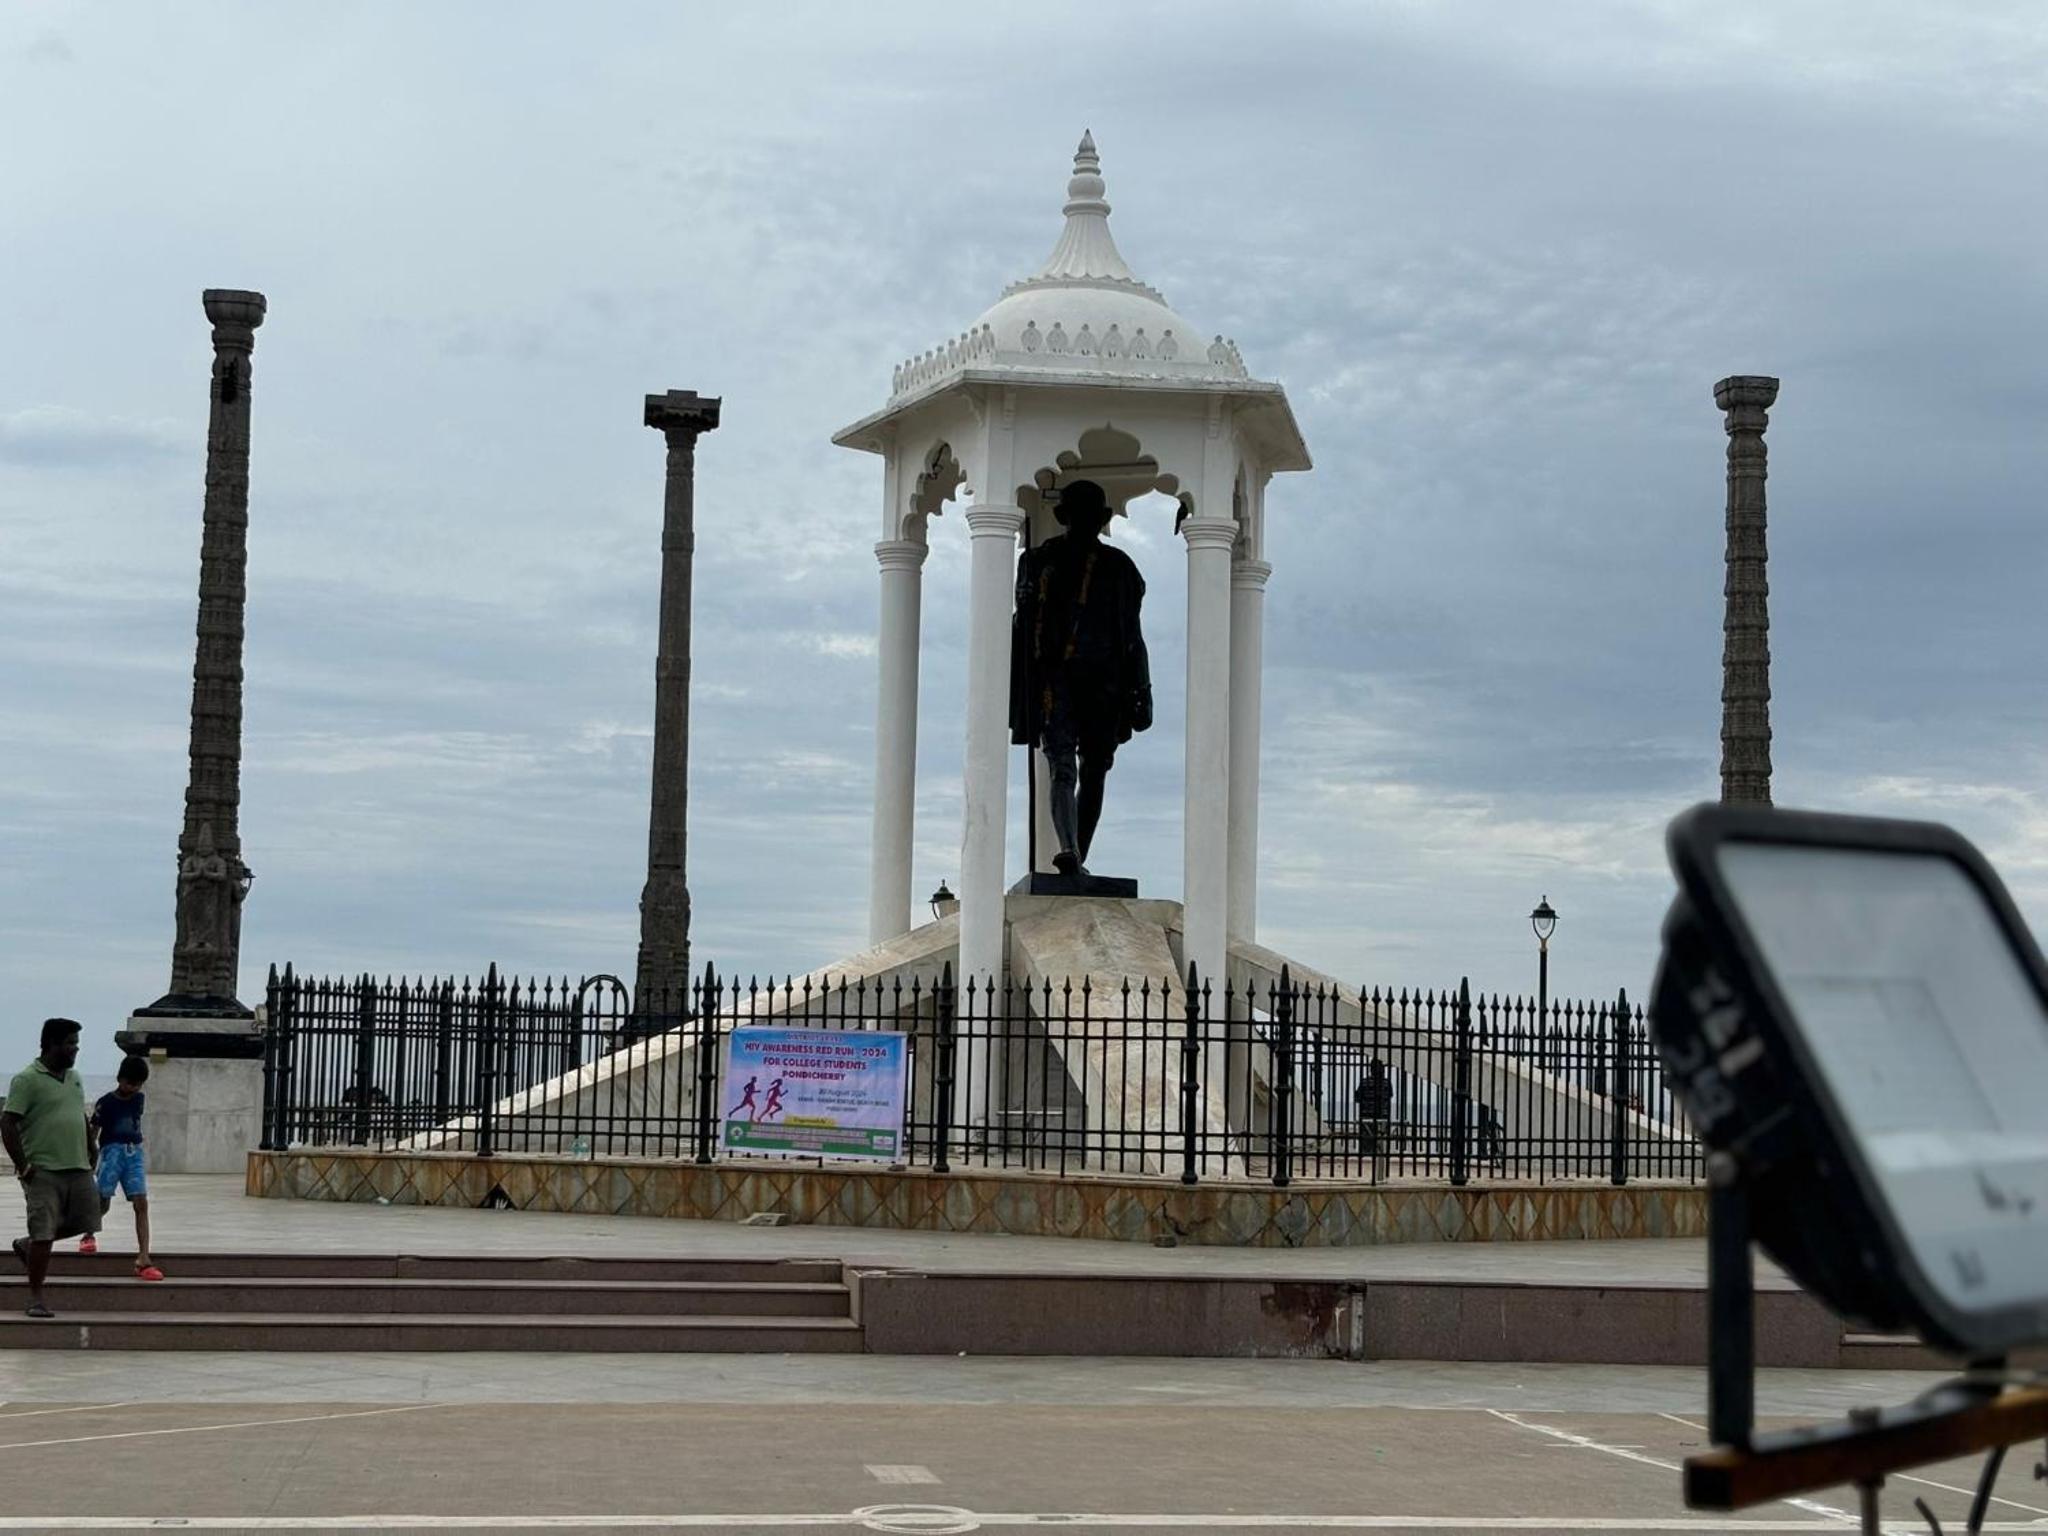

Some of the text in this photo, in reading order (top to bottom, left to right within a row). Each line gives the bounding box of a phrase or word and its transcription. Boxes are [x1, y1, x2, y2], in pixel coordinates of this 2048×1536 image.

[745, 1043, 887, 1057] HIV AWARENESS RED RUN 2024
[763, 1056, 867, 1070] FOR COLLEGE STUDENTS
[782, 1070, 847, 1081] PONDICHERRY
